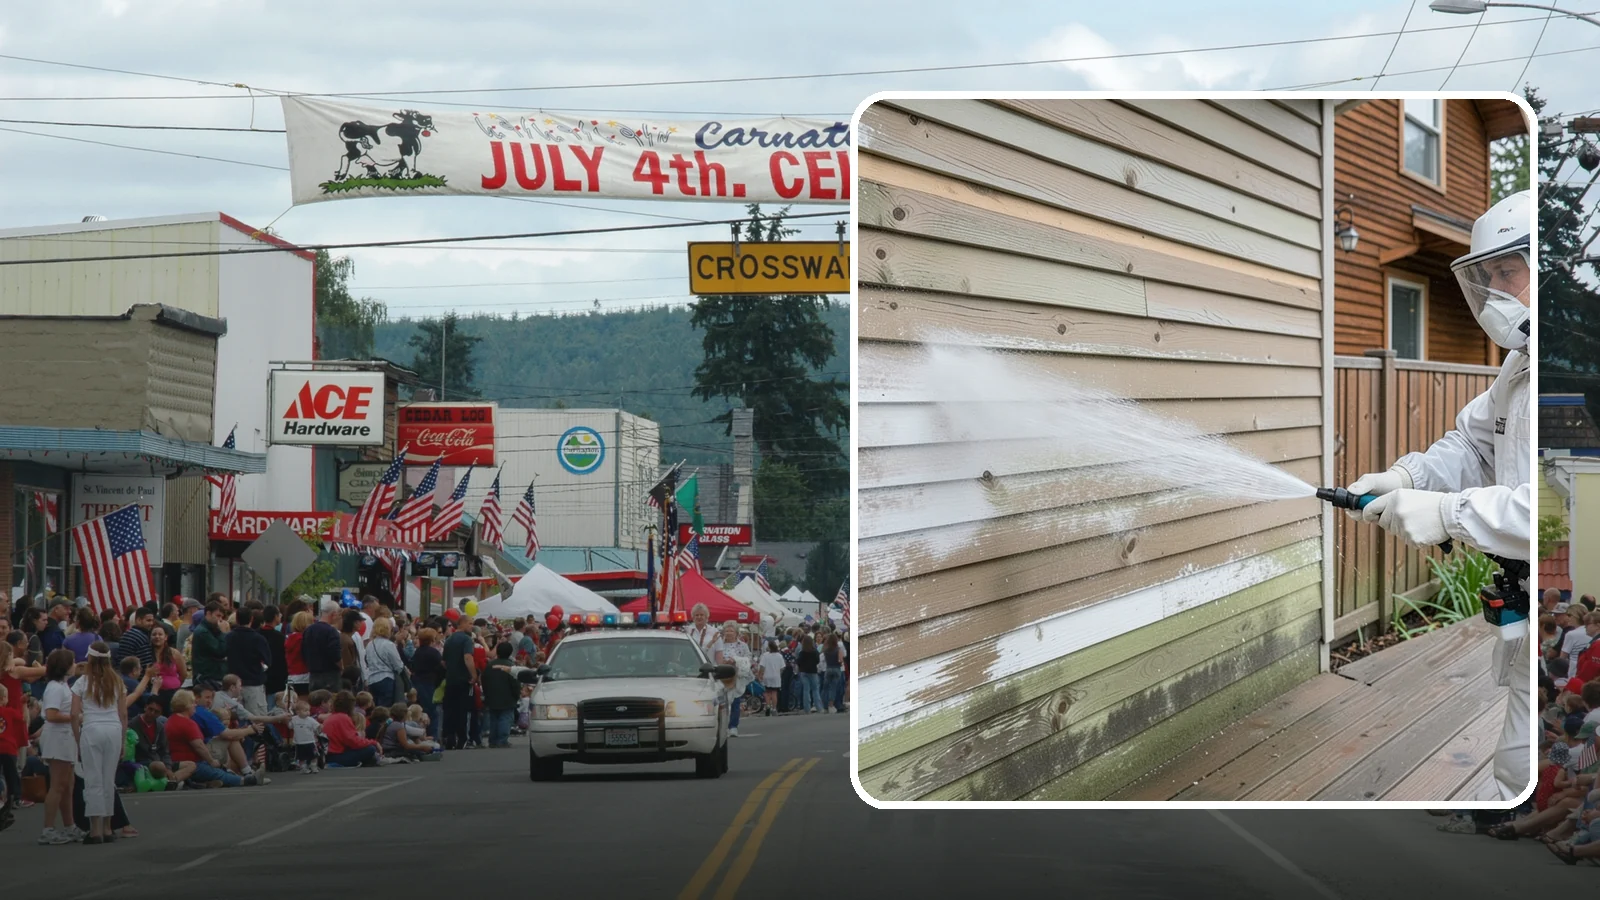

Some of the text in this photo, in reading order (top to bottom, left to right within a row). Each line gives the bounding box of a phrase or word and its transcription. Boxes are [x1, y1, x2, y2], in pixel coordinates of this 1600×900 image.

[481, 141, 604, 192] JULY
[632, 151, 746, 197] 4th.
[697, 254, 850, 280] CROSSWA
[282, 379, 374, 420] ACE
[406, 409, 485, 421] CEDAR LOG
[284, 421, 371, 437] Hardware
[416, 428, 477, 447] Coca-Cola
[95, 485, 124, 495] Vincent
[126, 486, 136, 495] de
[137, 486, 155, 496] Paul
[688, 526, 741, 535] CRNATION
[699, 535, 730, 543] GLASS
